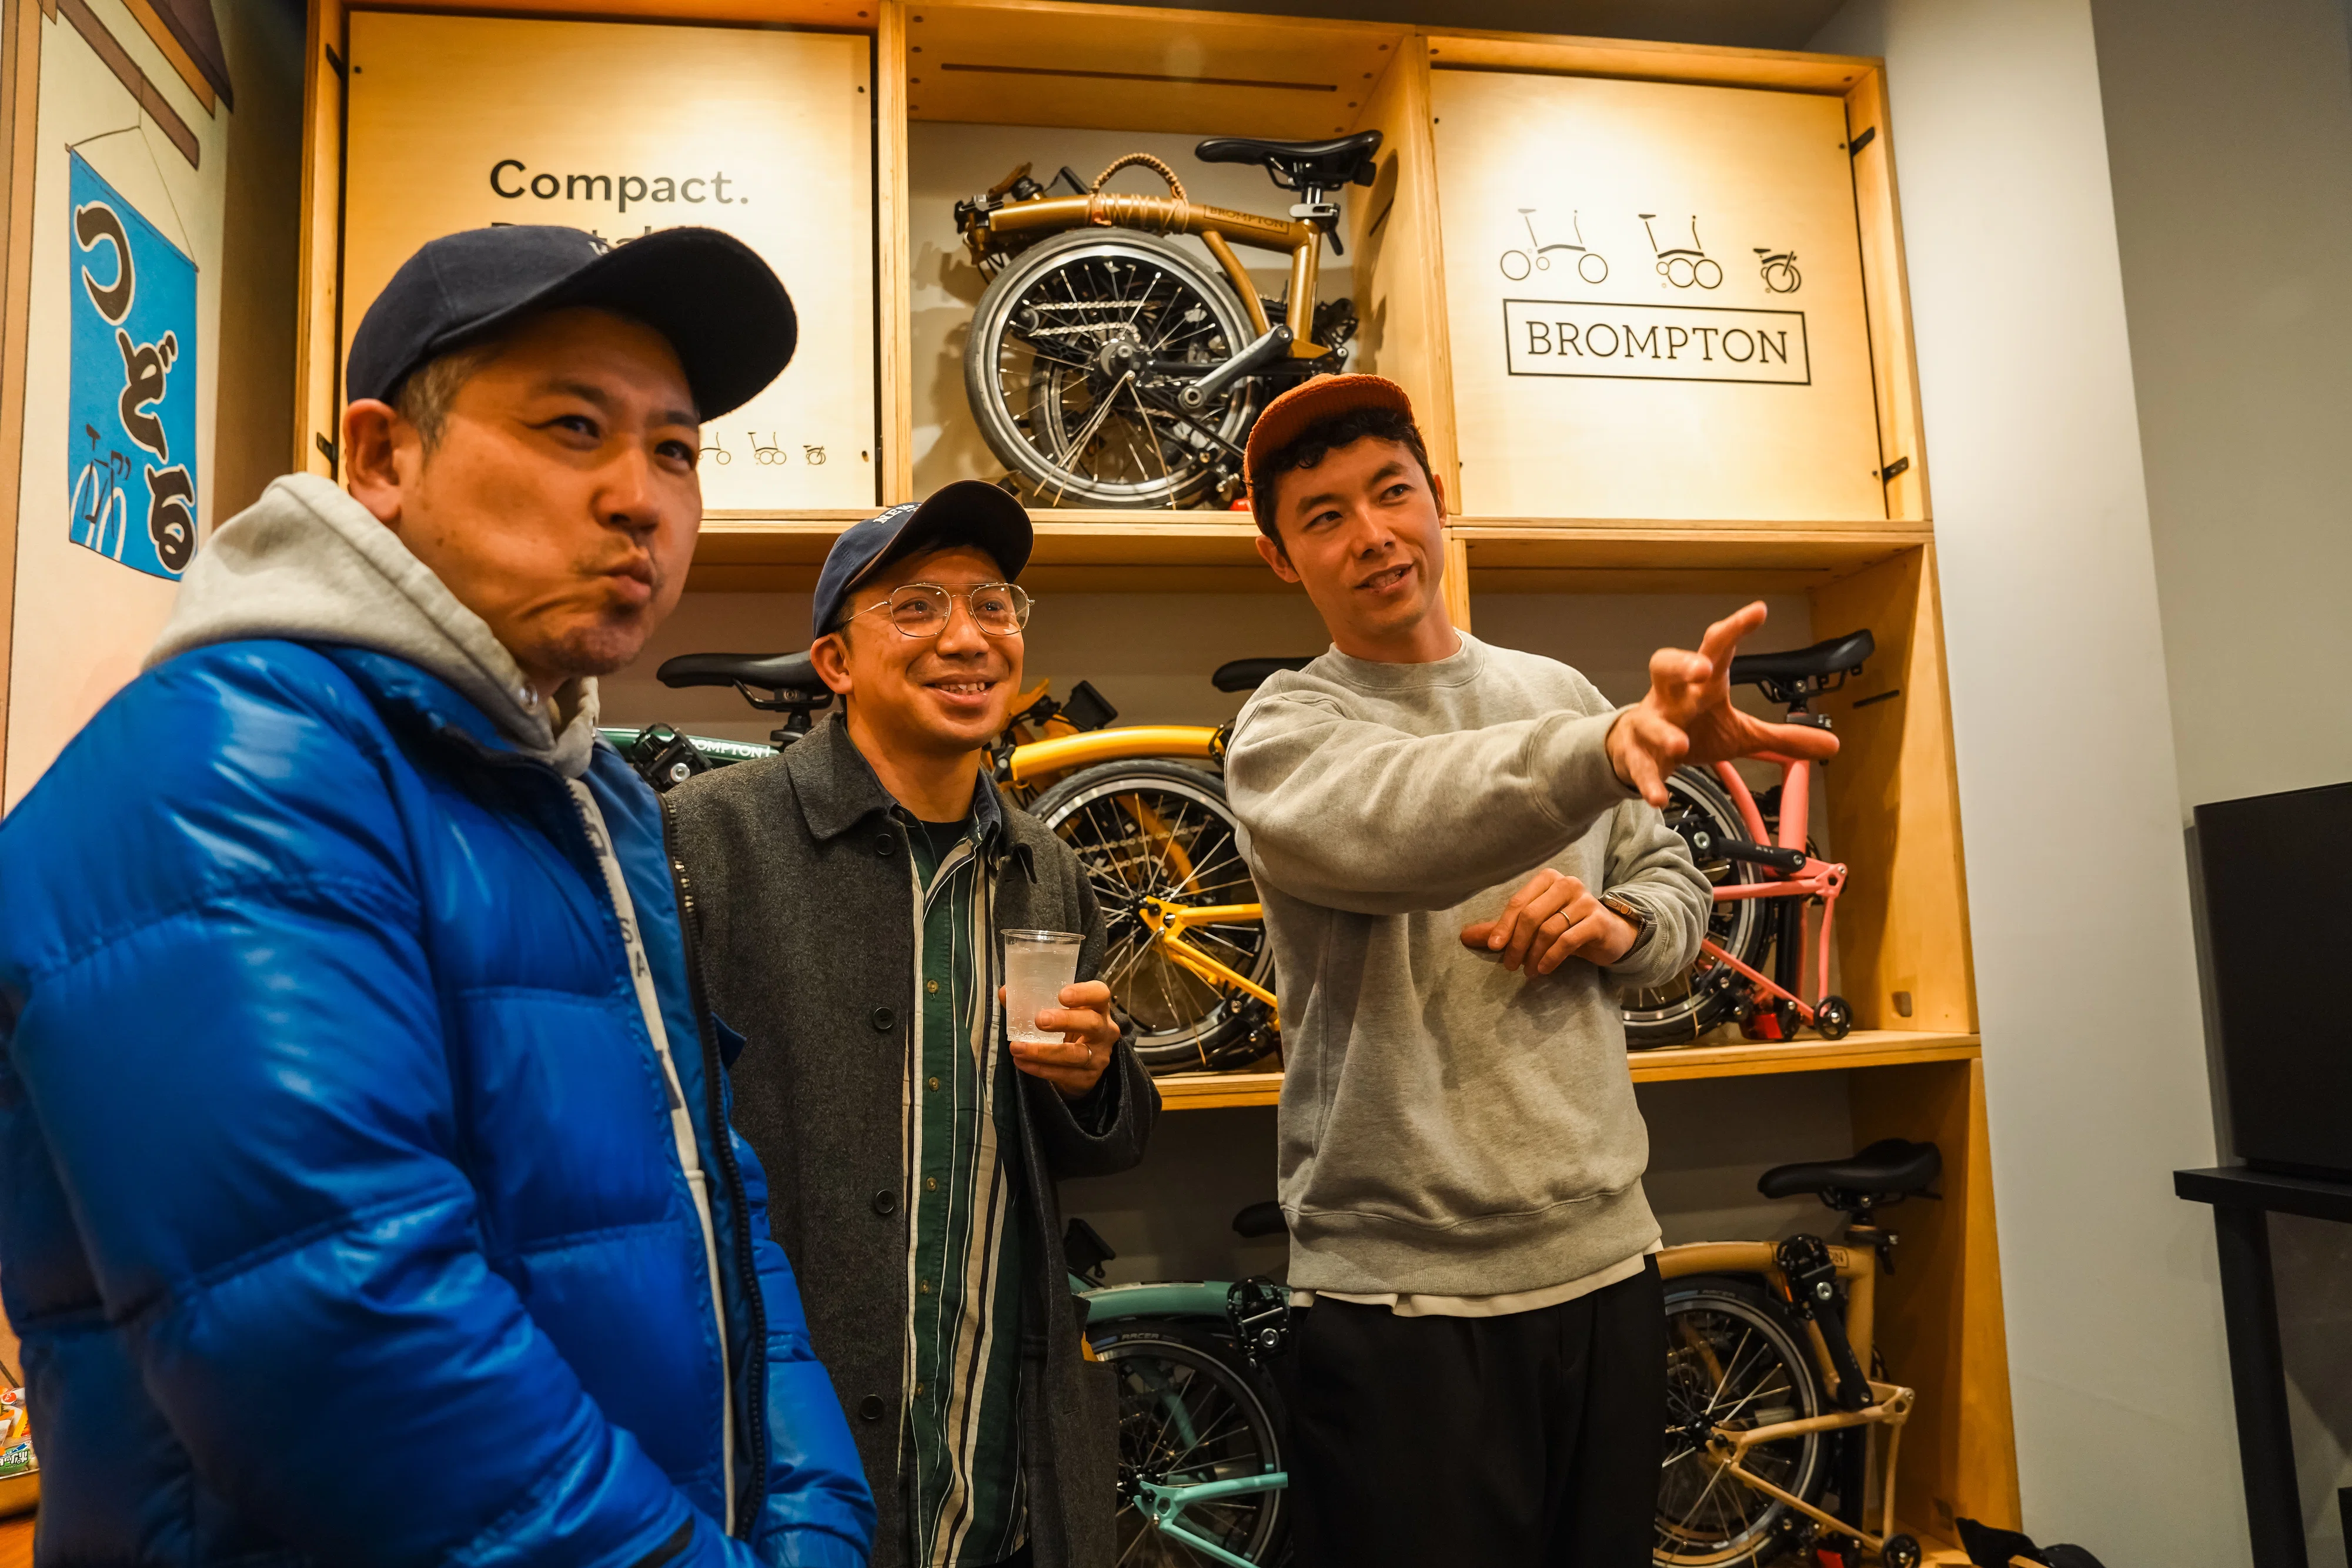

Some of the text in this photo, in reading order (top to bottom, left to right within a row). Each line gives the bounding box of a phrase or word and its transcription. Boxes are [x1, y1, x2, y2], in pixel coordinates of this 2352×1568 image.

[490, 159, 749, 213] Compact.
[1210, 206, 1284, 228] BROMPTON
[1526, 320, 1788, 364] BROMPTON
[689, 738, 763, 758] OMPTON
